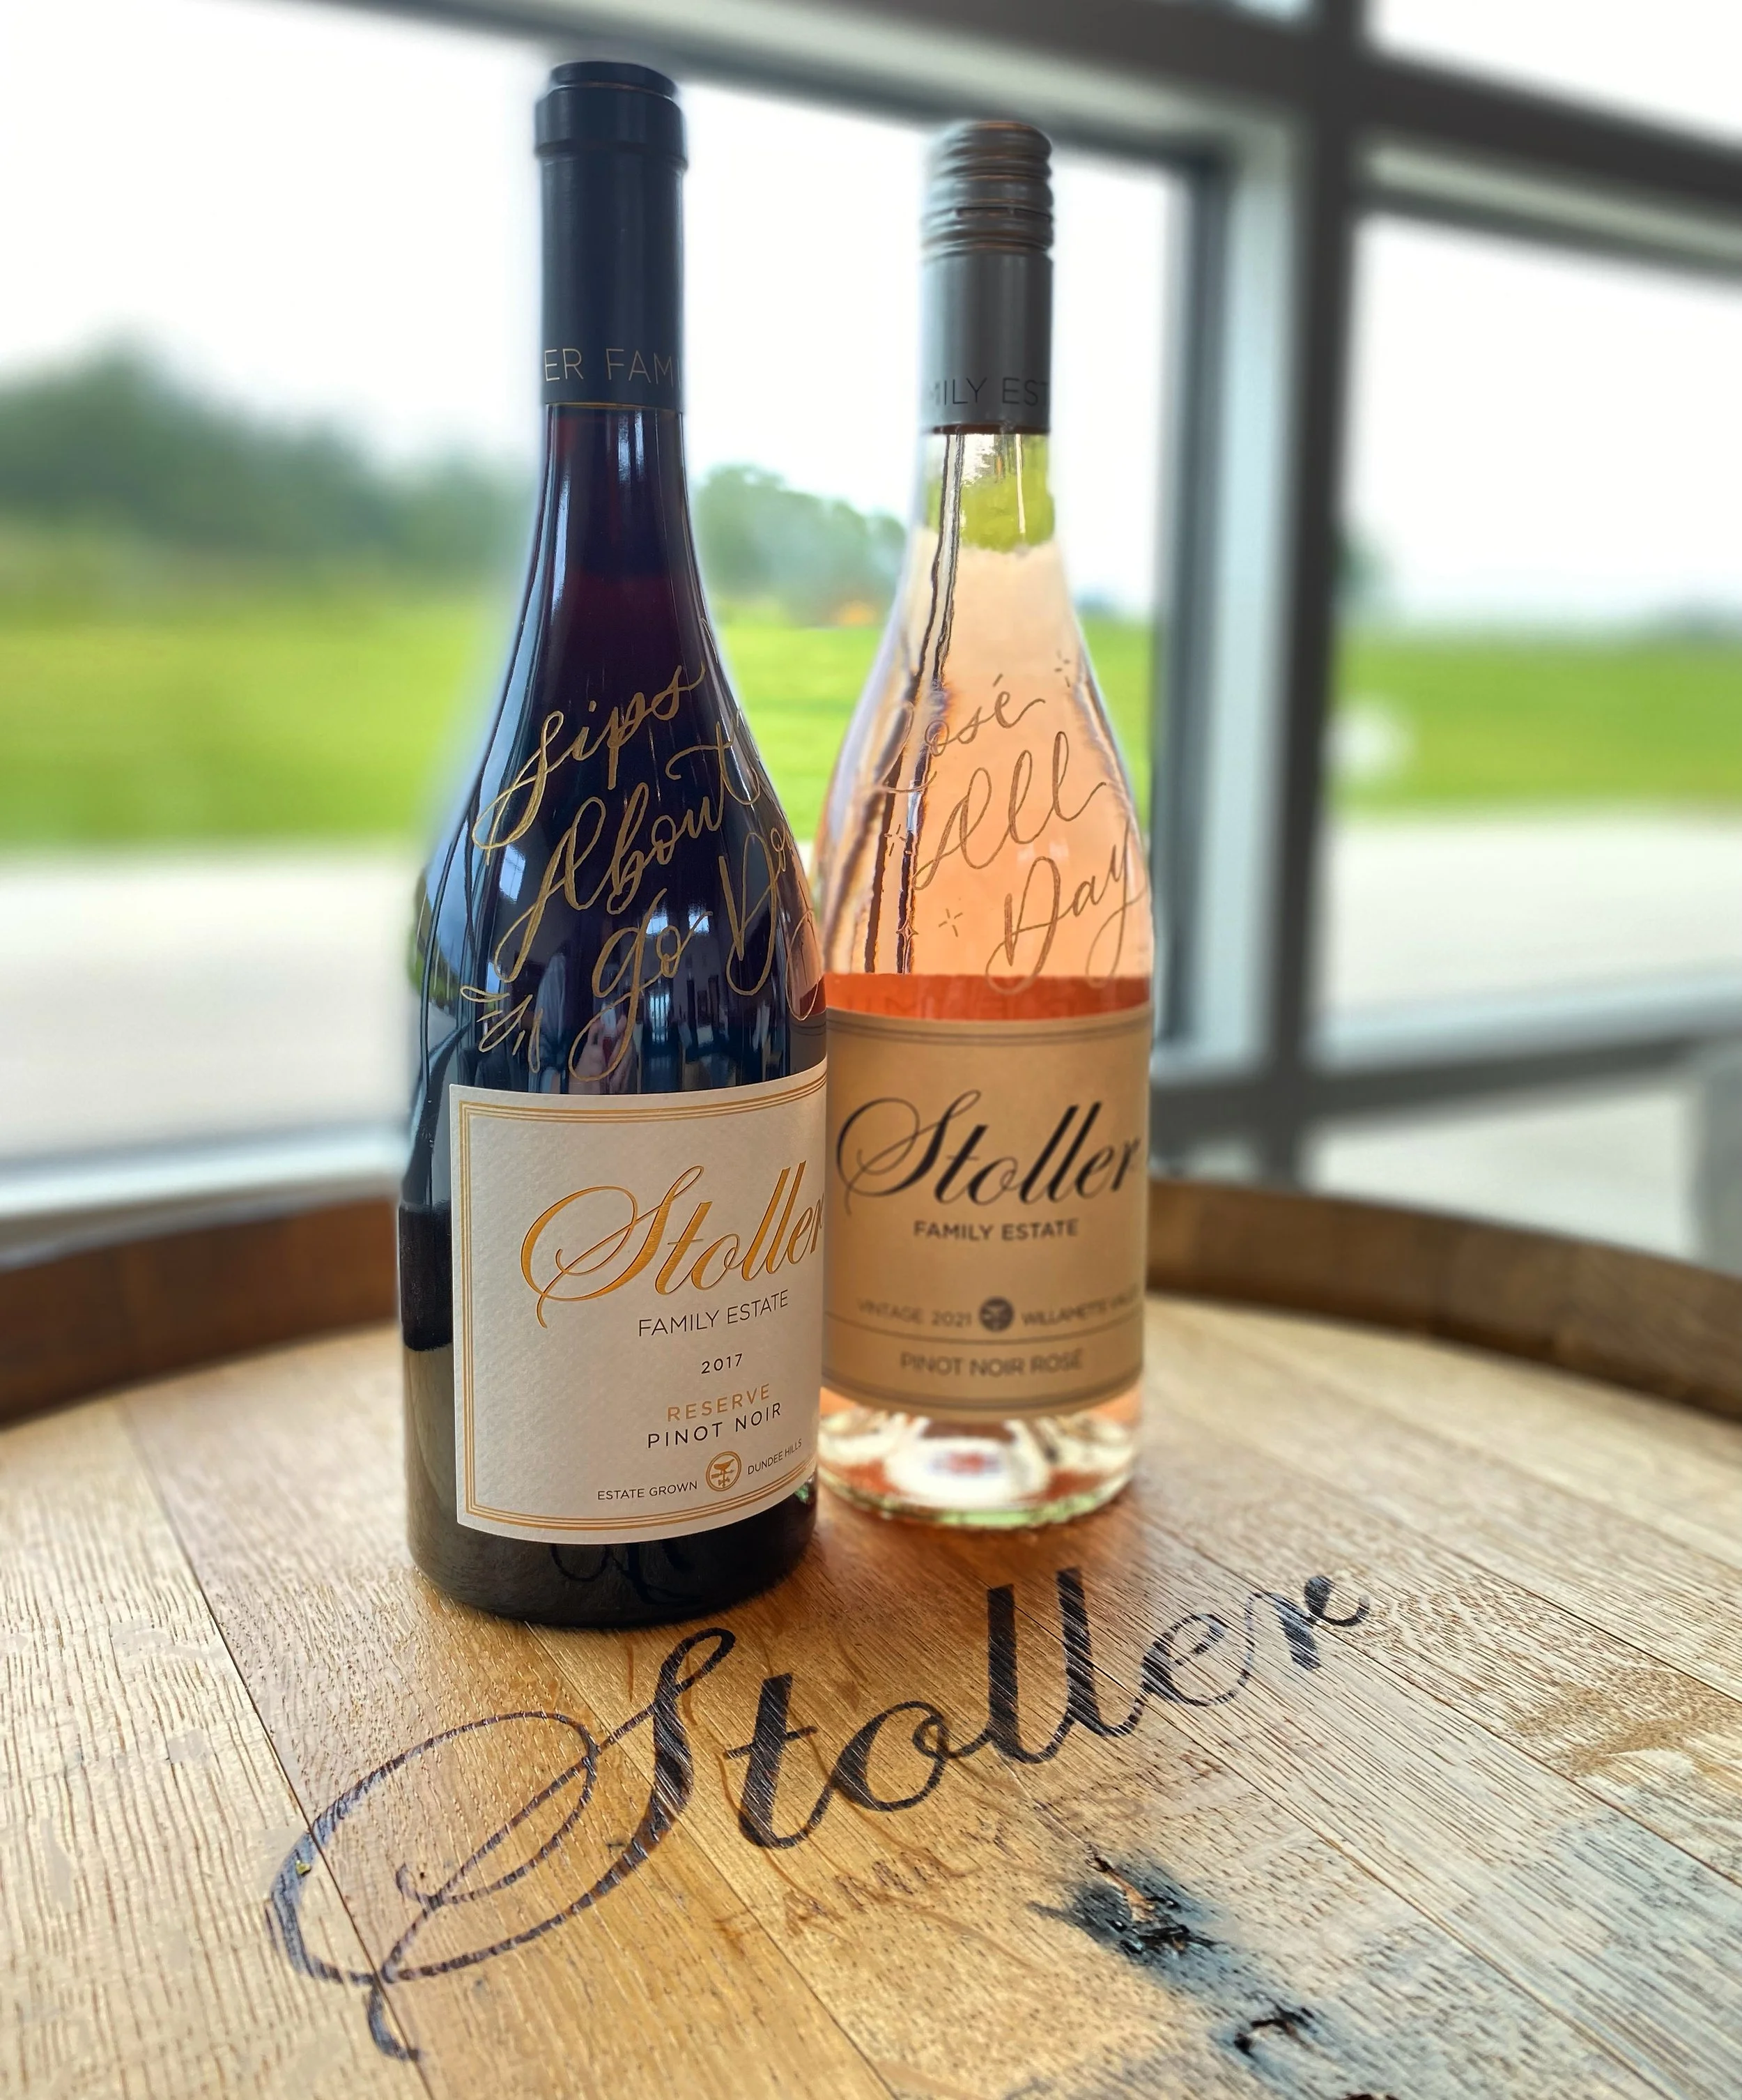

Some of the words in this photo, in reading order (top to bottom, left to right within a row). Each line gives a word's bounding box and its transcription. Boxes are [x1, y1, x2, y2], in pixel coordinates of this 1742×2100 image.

[544, 348, 585, 382] ER
[911, 730, 1107, 891] All
[494, 720, 761, 983] About
[985, 815, 1147, 995] Day
[836, 1089, 1143, 1216] Stoller
[520, 1160, 825, 1329] Stoller
[913, 1220, 994, 1241] FAMILY
[1001, 1218, 1079, 1241] ESTATE
[638, 1309, 720, 1337] FAMILY
[727, 1289, 789, 1324] ESTATE
[931, 1309, 972, 1328] 2021
[701, 1353, 743, 1374] 2017
[900, 1350, 962, 1376] PINOT
[969, 1357, 1025, 1378] NOIR
[647, 1421, 723, 1449] PINOT
[734, 1402, 782, 1432] NOIR
[667, 1383, 770, 1423] RESERVE
[597, 1488, 645, 1501] ESTATE
[649, 1480, 697, 1497] GROWN
[747, 1453, 783, 1476] DUNDEE
[784, 1438, 803, 1460] HILLS
[265, 1566, 1371, 2062] Stoller
